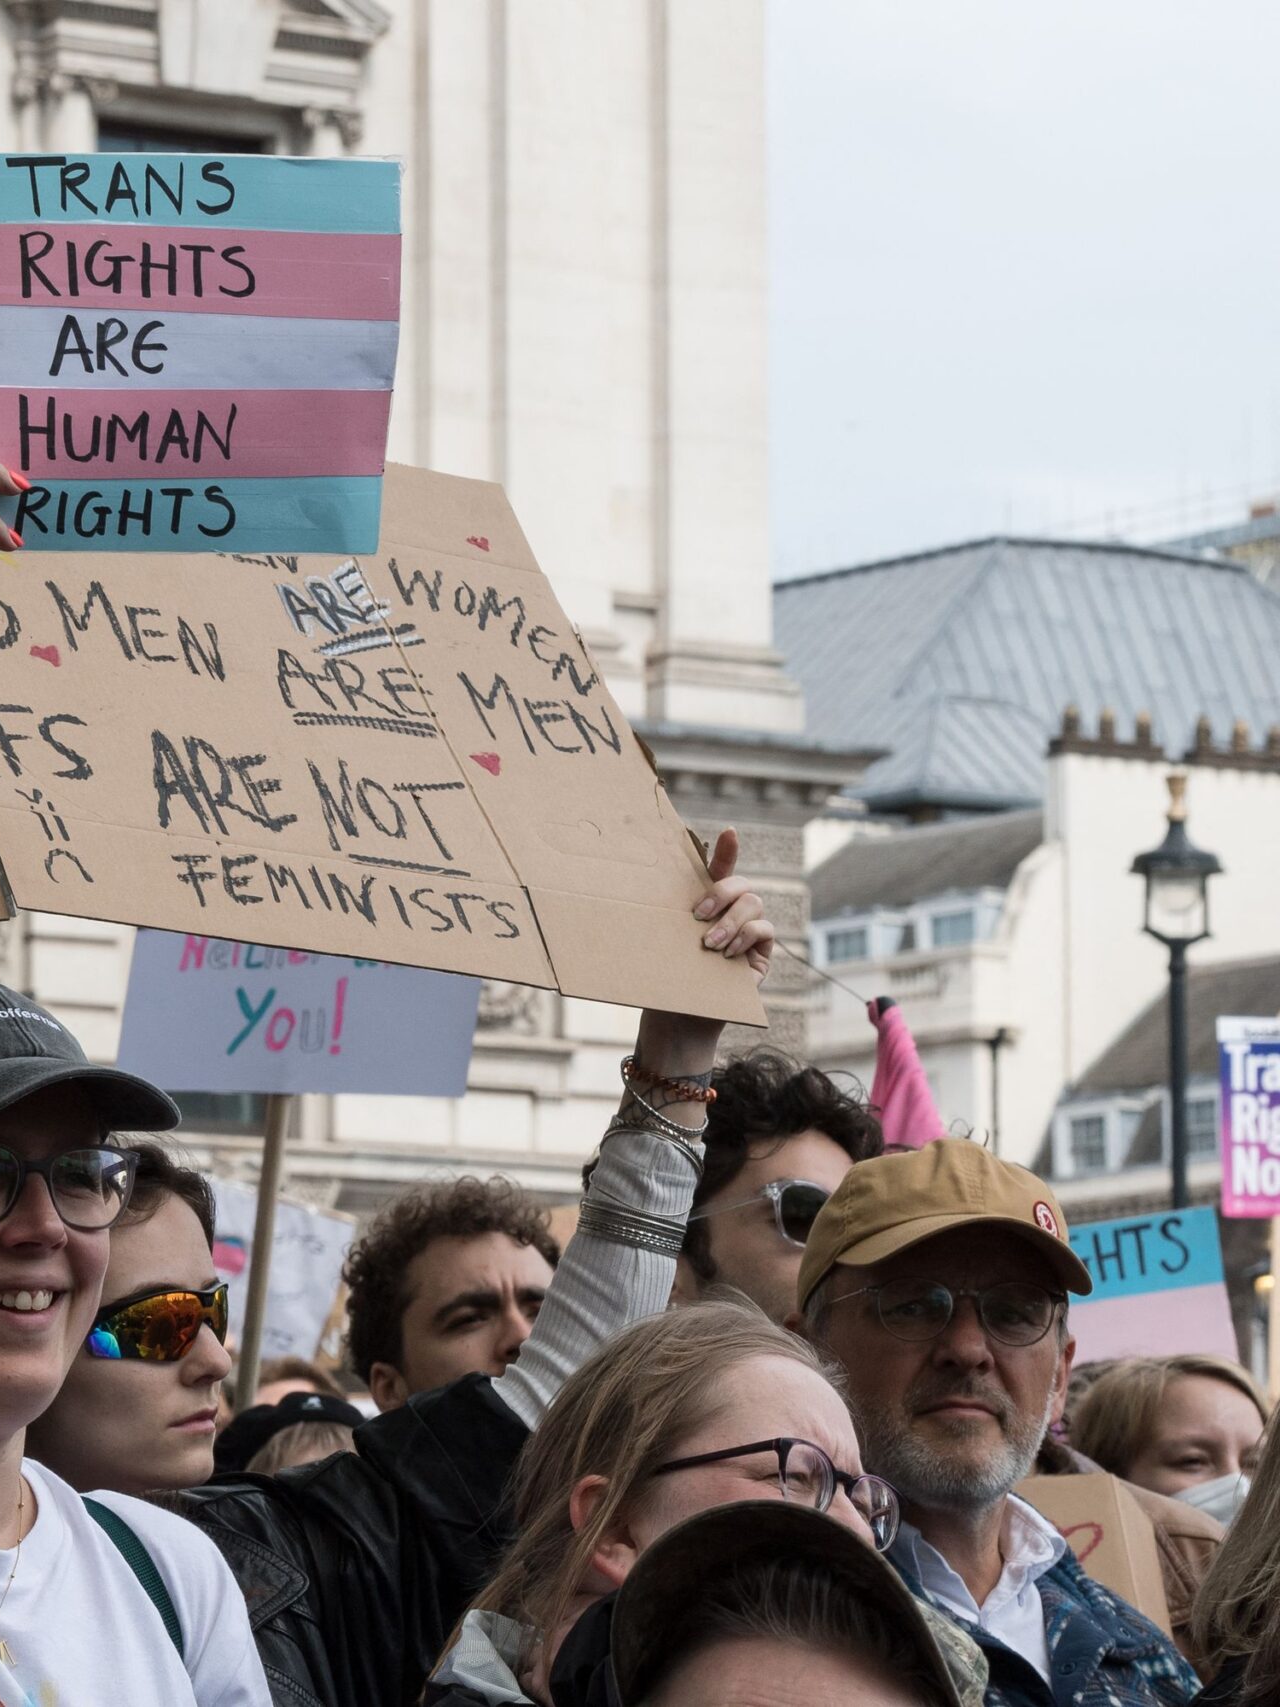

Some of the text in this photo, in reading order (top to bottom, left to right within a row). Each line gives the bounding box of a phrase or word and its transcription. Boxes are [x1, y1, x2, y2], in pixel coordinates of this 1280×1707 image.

[5, 156, 236, 217] TRANS
[19, 231, 256, 298] RIGHTS
[48, 314, 168, 378] ARE
[19, 394, 237, 471] HUMAN
[15, 485, 237, 538] RIGHTS
[276, 559, 390, 637] ARE
[388, 557, 600, 697] WOMEN
[45, 578, 225, 682] MEN
[277, 648, 436, 719] ARE
[457, 671, 622, 756] MEN
[151, 728, 299, 836] ARE
[308, 757, 465, 861] NOT
[170, 850, 522, 939] FEMINISTS
